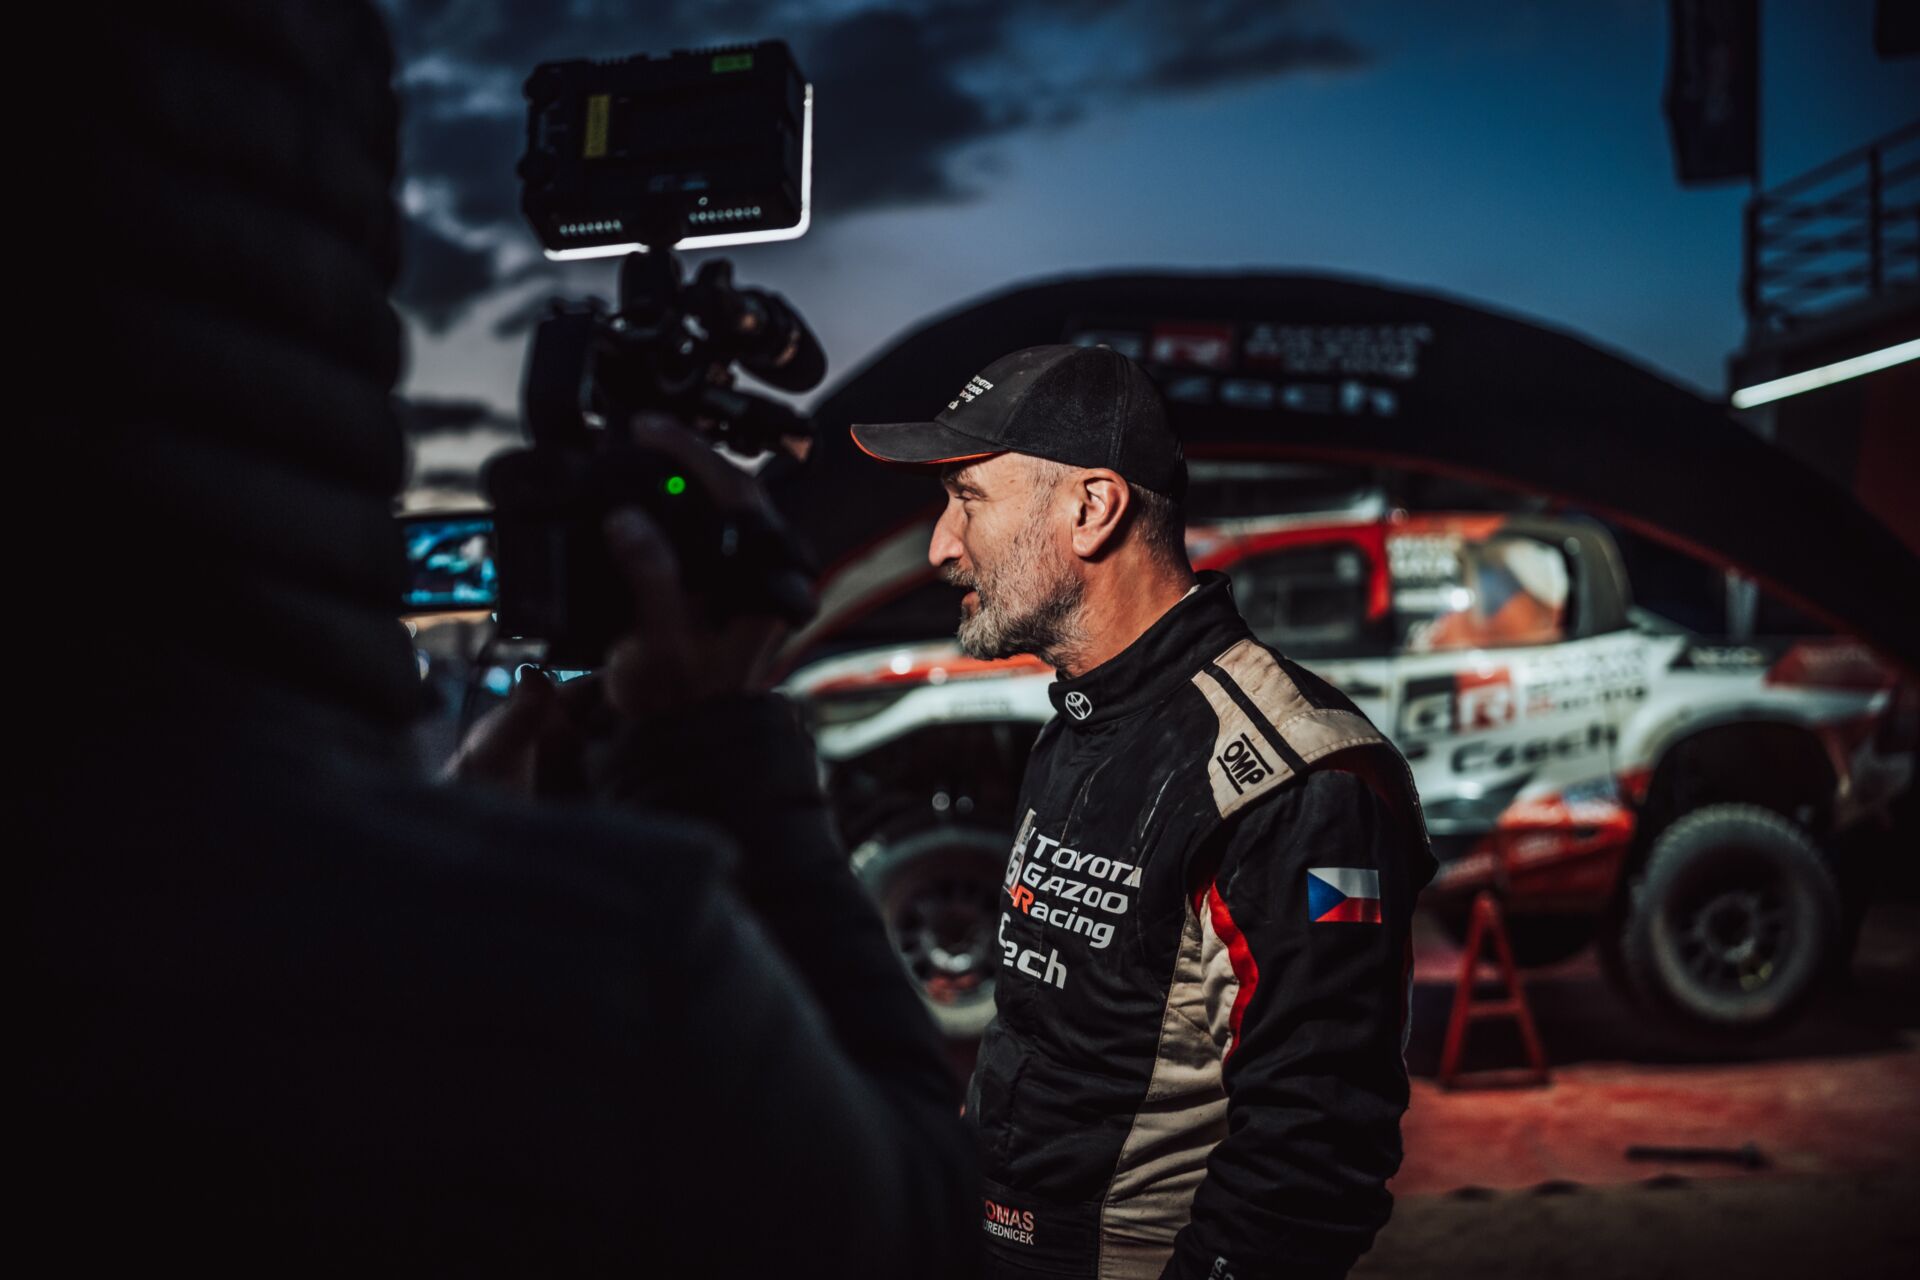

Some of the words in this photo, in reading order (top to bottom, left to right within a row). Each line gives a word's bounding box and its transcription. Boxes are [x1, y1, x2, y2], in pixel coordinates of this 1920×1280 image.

[1223, 740, 1266, 785] OMP
[1022, 861, 1129, 915] GAZOO
[1033, 833, 1143, 889] TOYOTA
[1011, 884, 1116, 950] Racing
